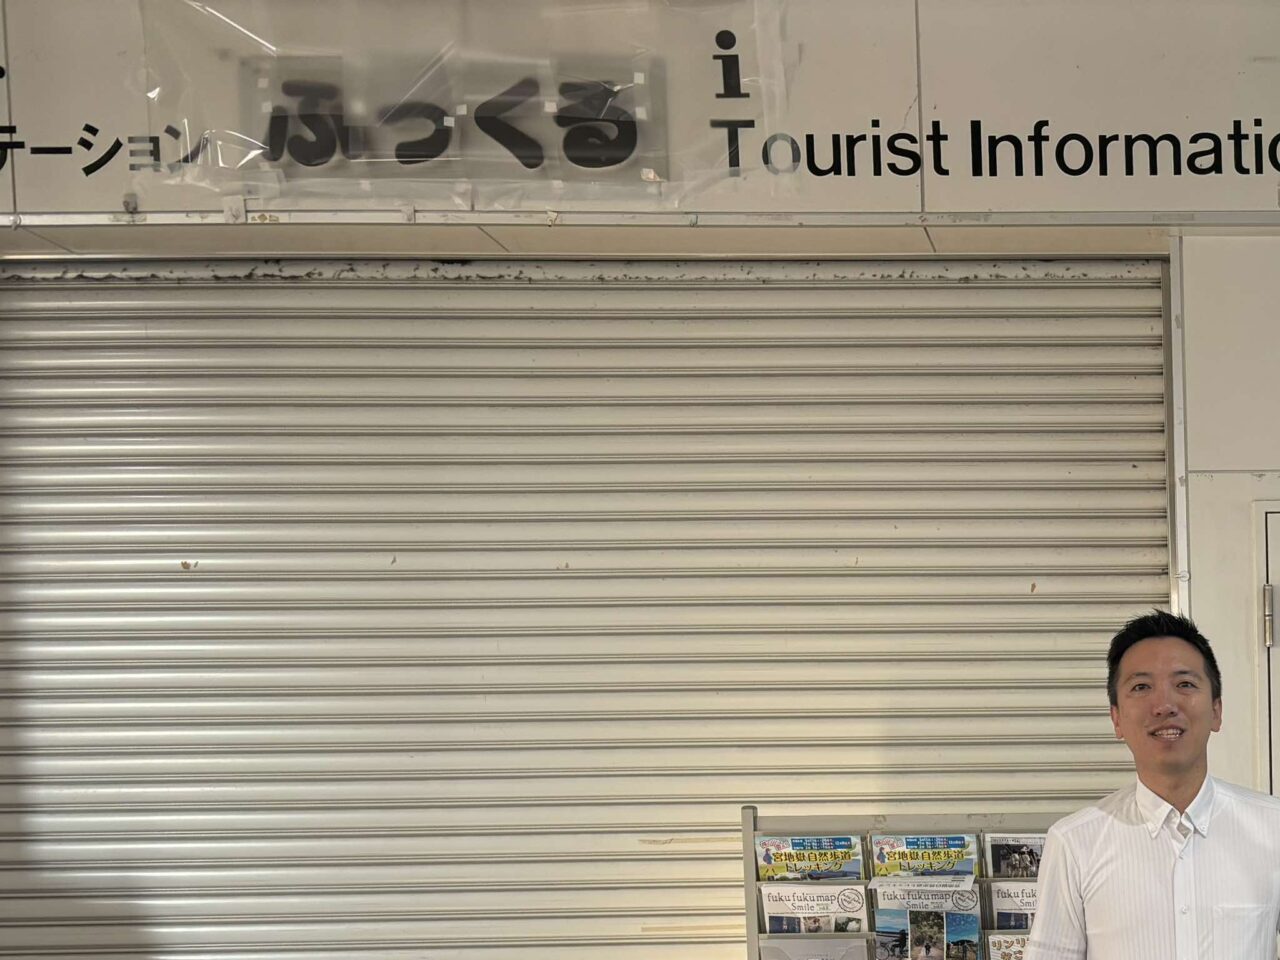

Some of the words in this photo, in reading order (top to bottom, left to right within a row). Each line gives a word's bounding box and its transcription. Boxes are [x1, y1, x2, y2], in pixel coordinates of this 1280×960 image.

[266, 78, 639, 169] ふっくる
[710, 119, 949, 177] Tourist
